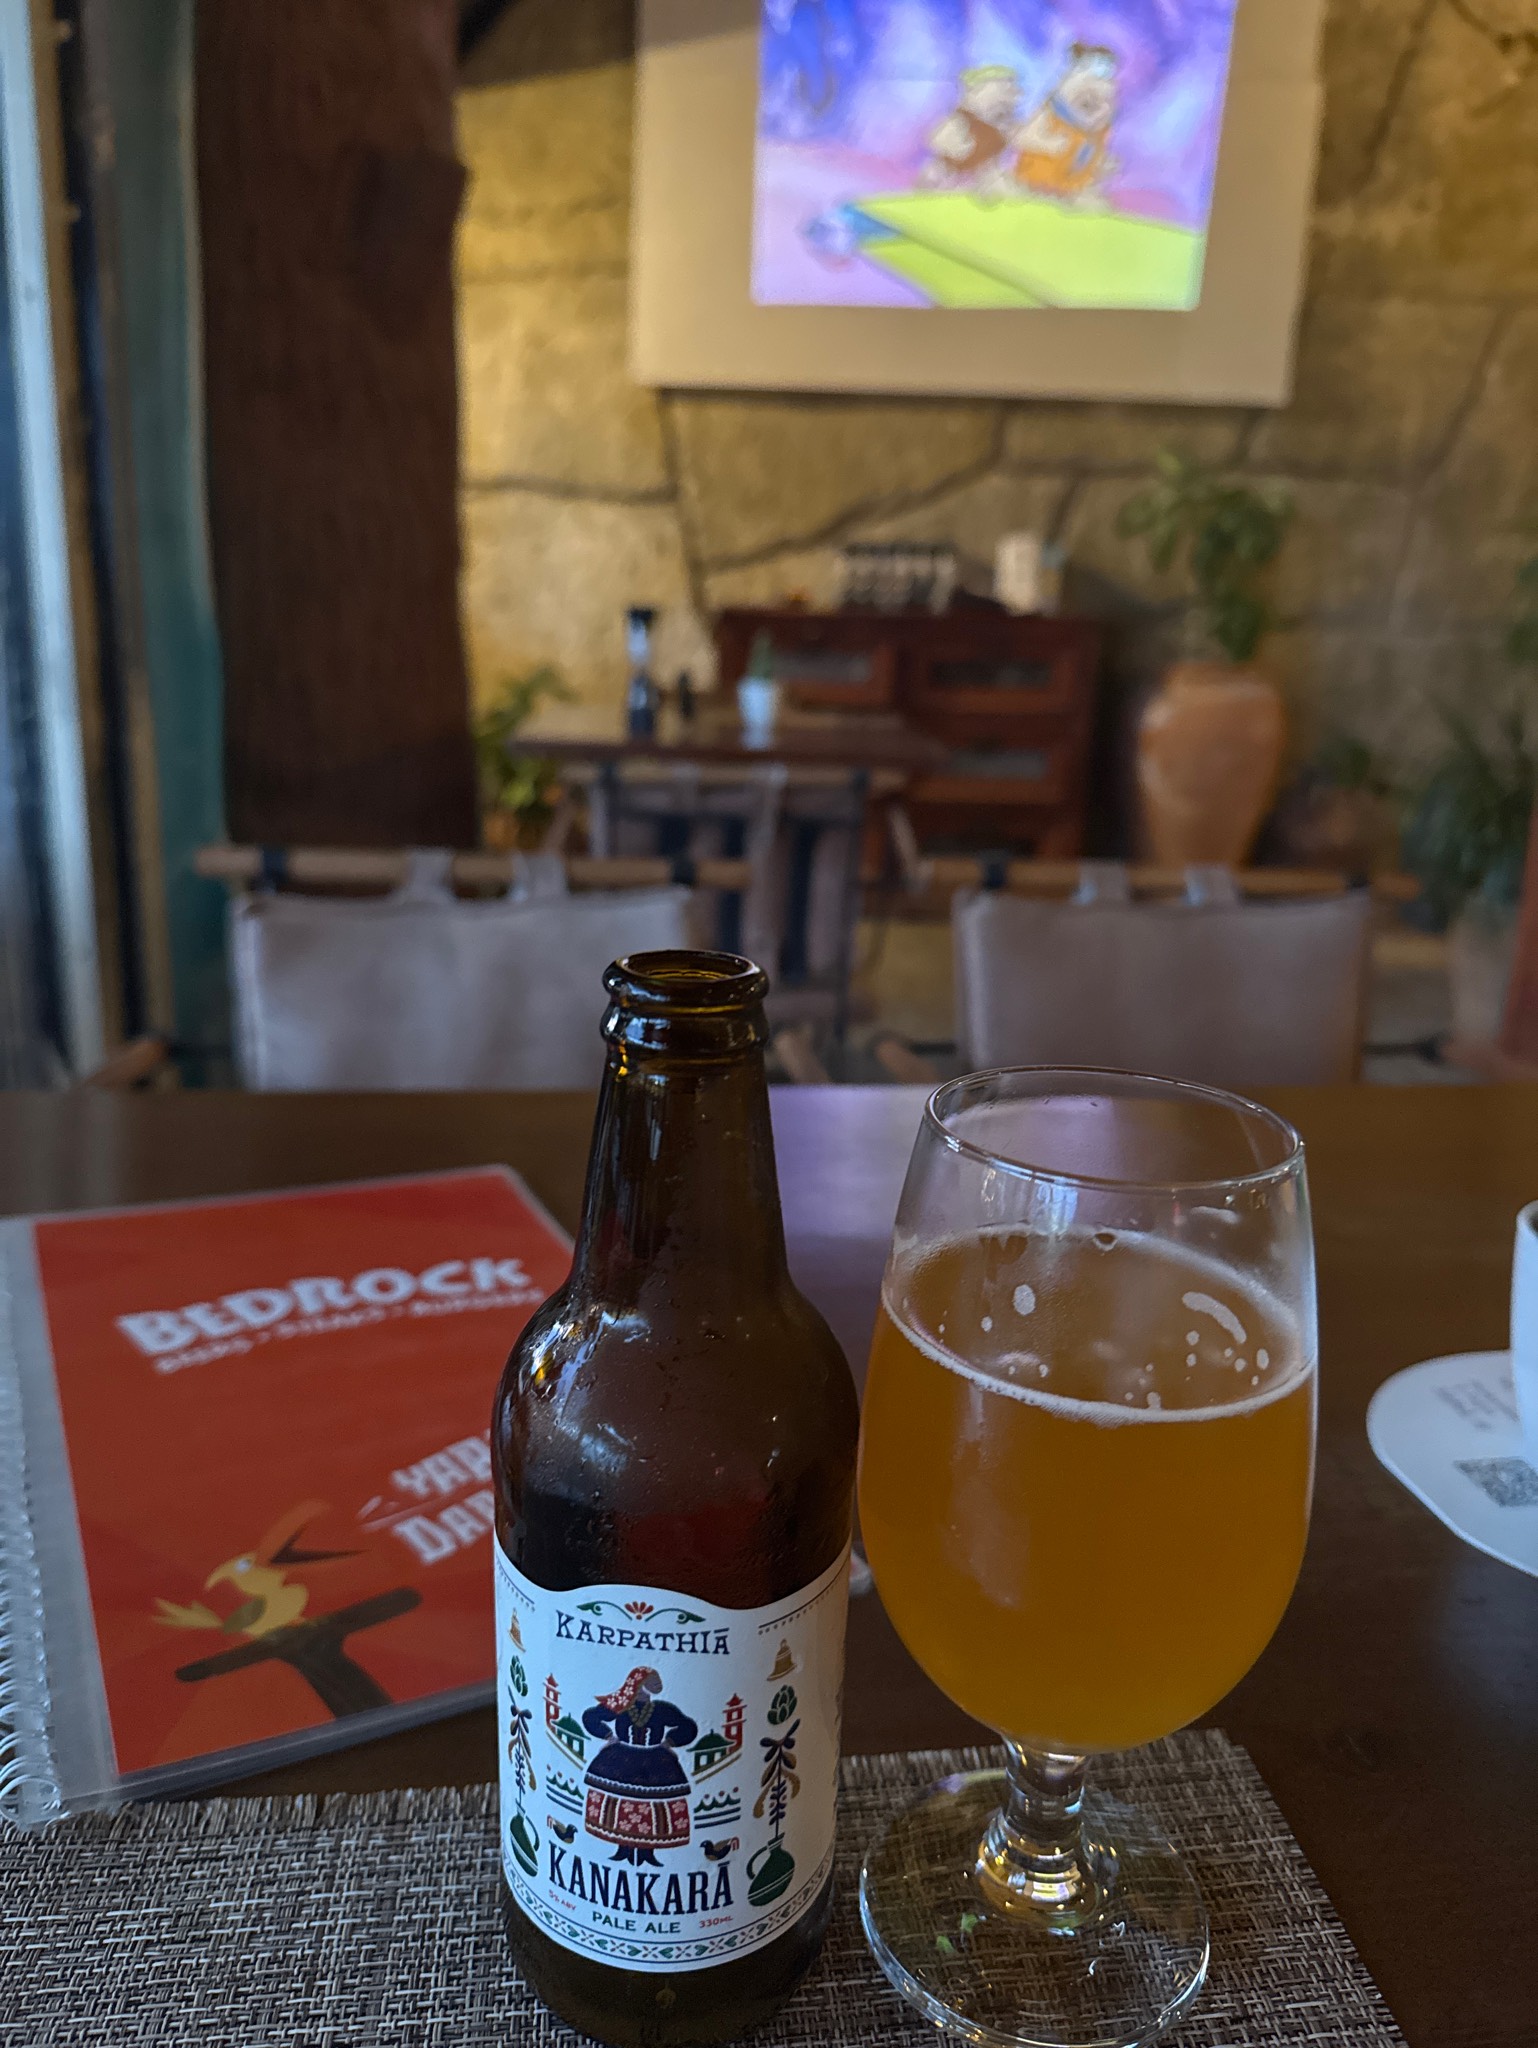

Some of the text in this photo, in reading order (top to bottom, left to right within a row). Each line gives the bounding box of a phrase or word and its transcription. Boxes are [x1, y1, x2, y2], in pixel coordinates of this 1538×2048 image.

[116, 1258, 532, 1354] BEDROCK
[390, 1428, 491, 1497] YAB
[592, 1911, 682, 1935] PALE ALE
